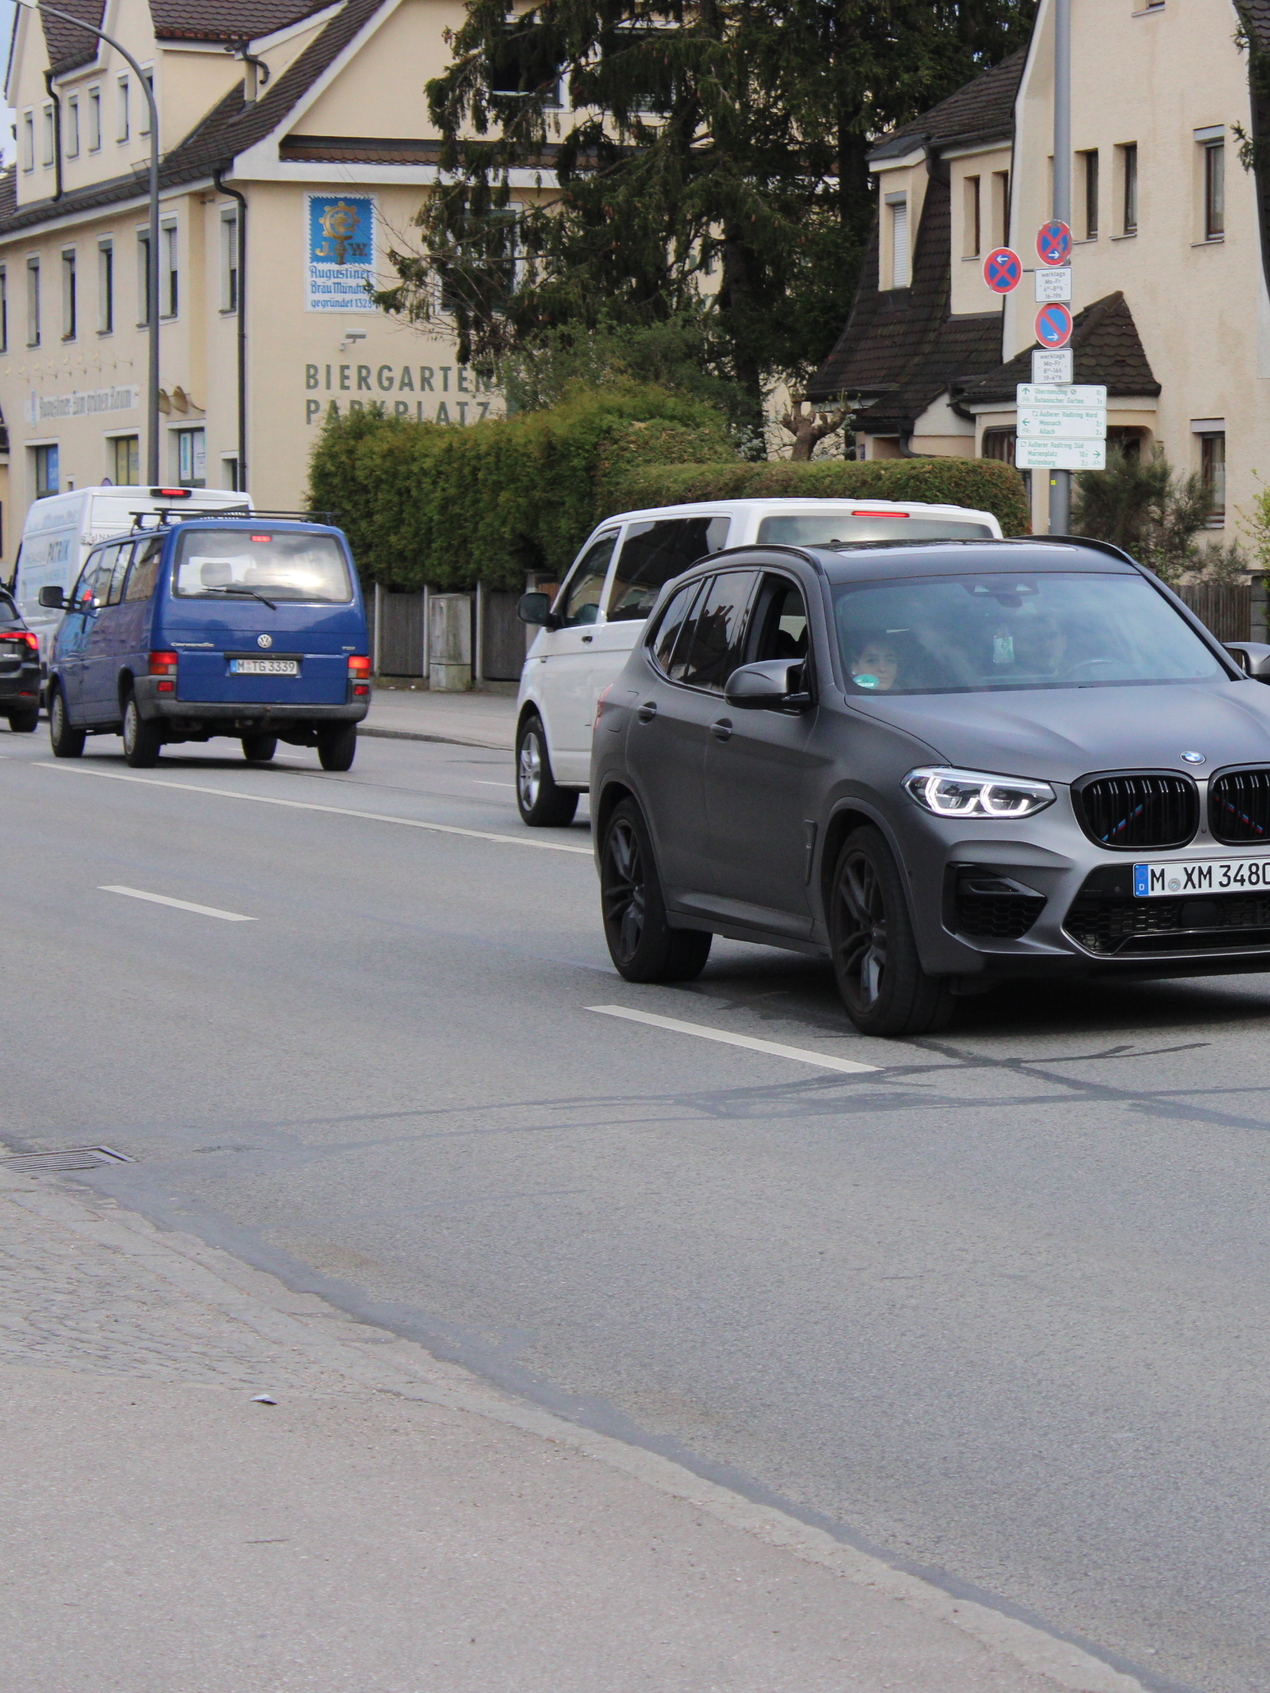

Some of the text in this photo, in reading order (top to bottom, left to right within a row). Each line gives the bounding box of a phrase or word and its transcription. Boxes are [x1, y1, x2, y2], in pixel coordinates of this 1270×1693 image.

[310, 280, 373, 294] Bräu Münch
[310, 298, 353, 308] gegründet
[306, 364, 494, 392] BIERGARTEN
[1034, 388, 1067, 396] Obermenzing
[1027, 459, 1056, 467] Blutenburg
[237, 660, 295, 672] M TG 3339
[1149, 867, 1165, 892] M
[1183, 865, 1213, 890] XM
